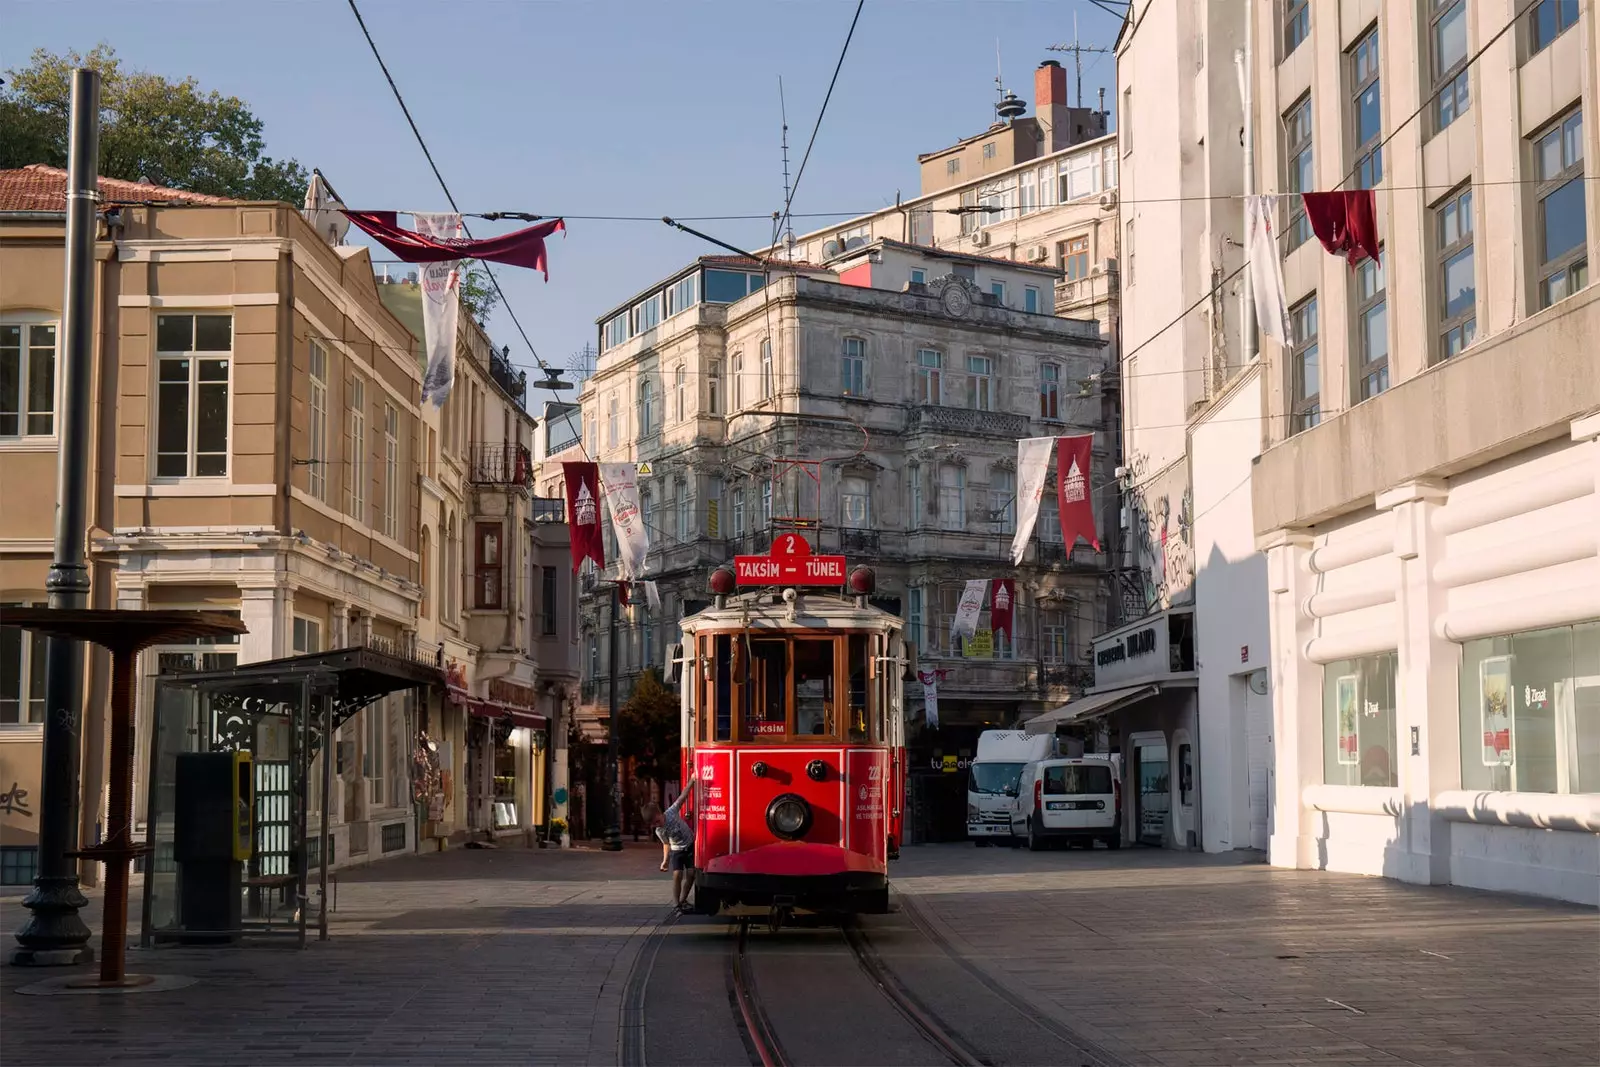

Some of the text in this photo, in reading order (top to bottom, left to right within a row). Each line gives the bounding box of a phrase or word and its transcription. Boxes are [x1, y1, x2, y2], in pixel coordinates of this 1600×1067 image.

[786, 536, 795, 554] 2
[739, 559, 780, 577] TAKSİM
[805, 558, 842, 576] TÜNEL
[748, 724, 784, 733] TAKSİM
[702, 765, 714, 780] 223
